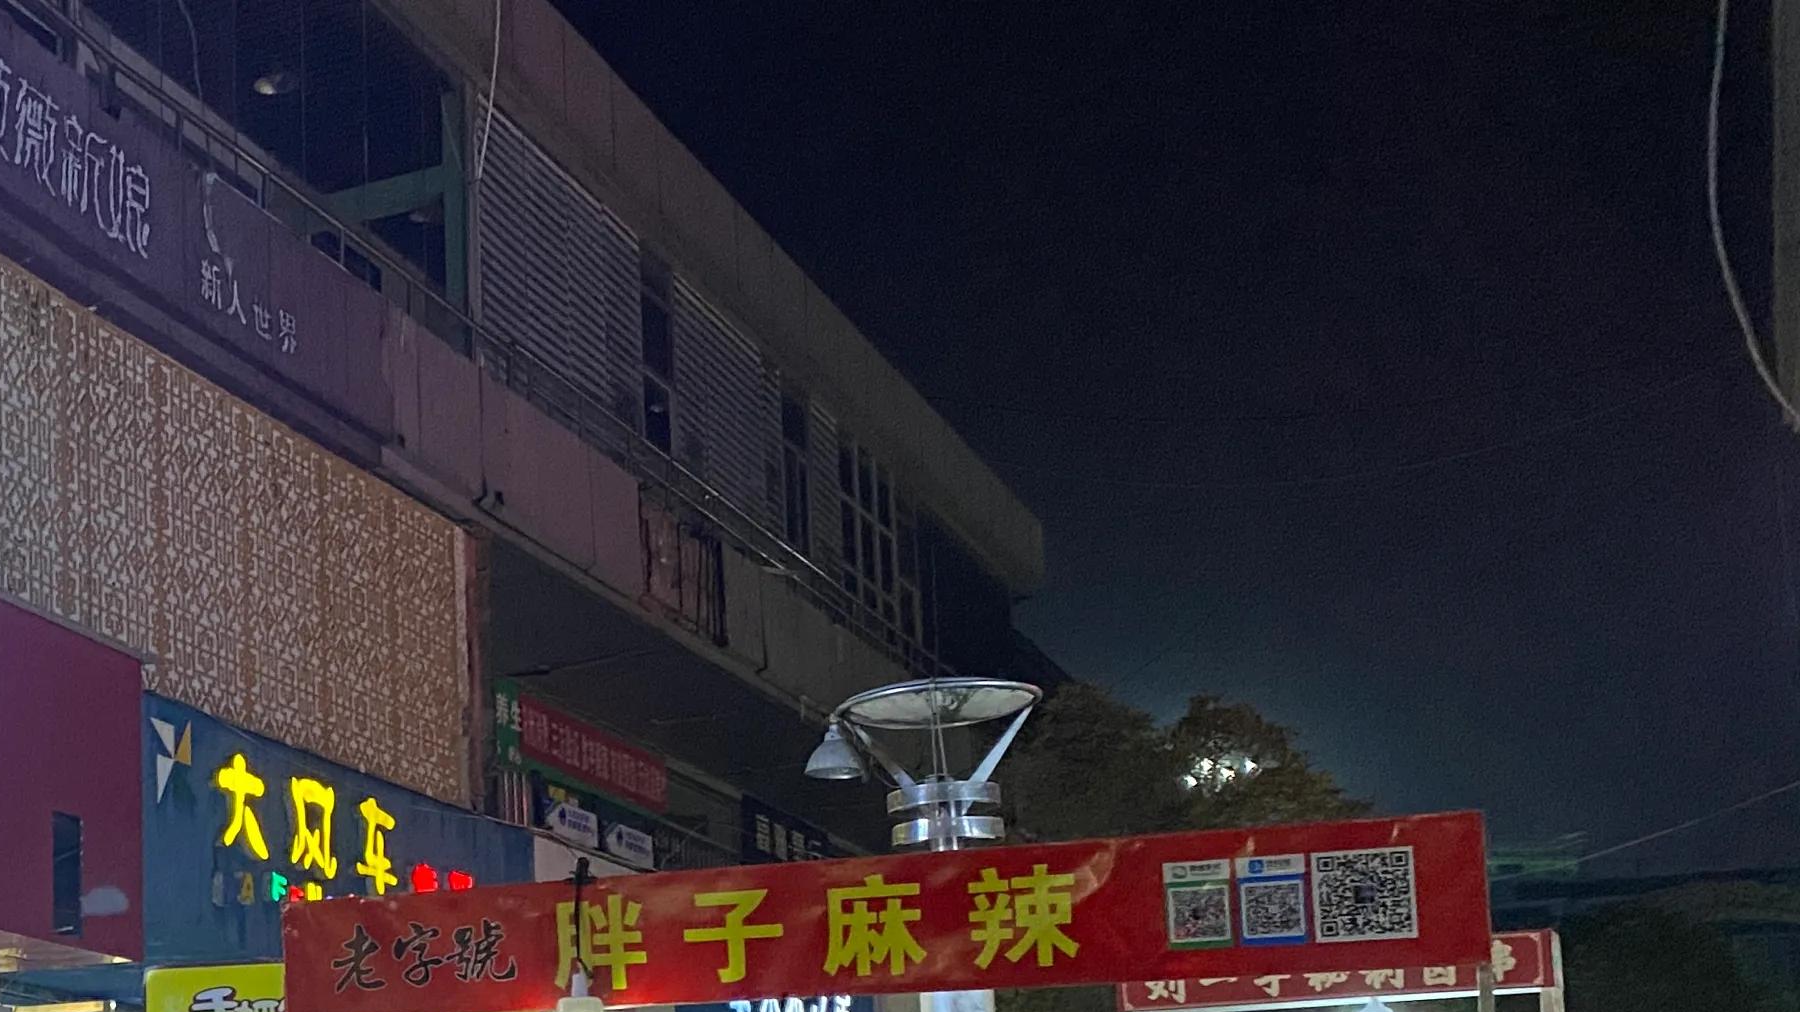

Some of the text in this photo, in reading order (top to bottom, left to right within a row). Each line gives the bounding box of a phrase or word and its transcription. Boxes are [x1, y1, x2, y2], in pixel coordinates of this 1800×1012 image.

[200, 258, 298, 356] 新人世界
[217, 752, 398, 895] 大风车
[331, 866, 1083, 993] 老字號 胖子麻辣
